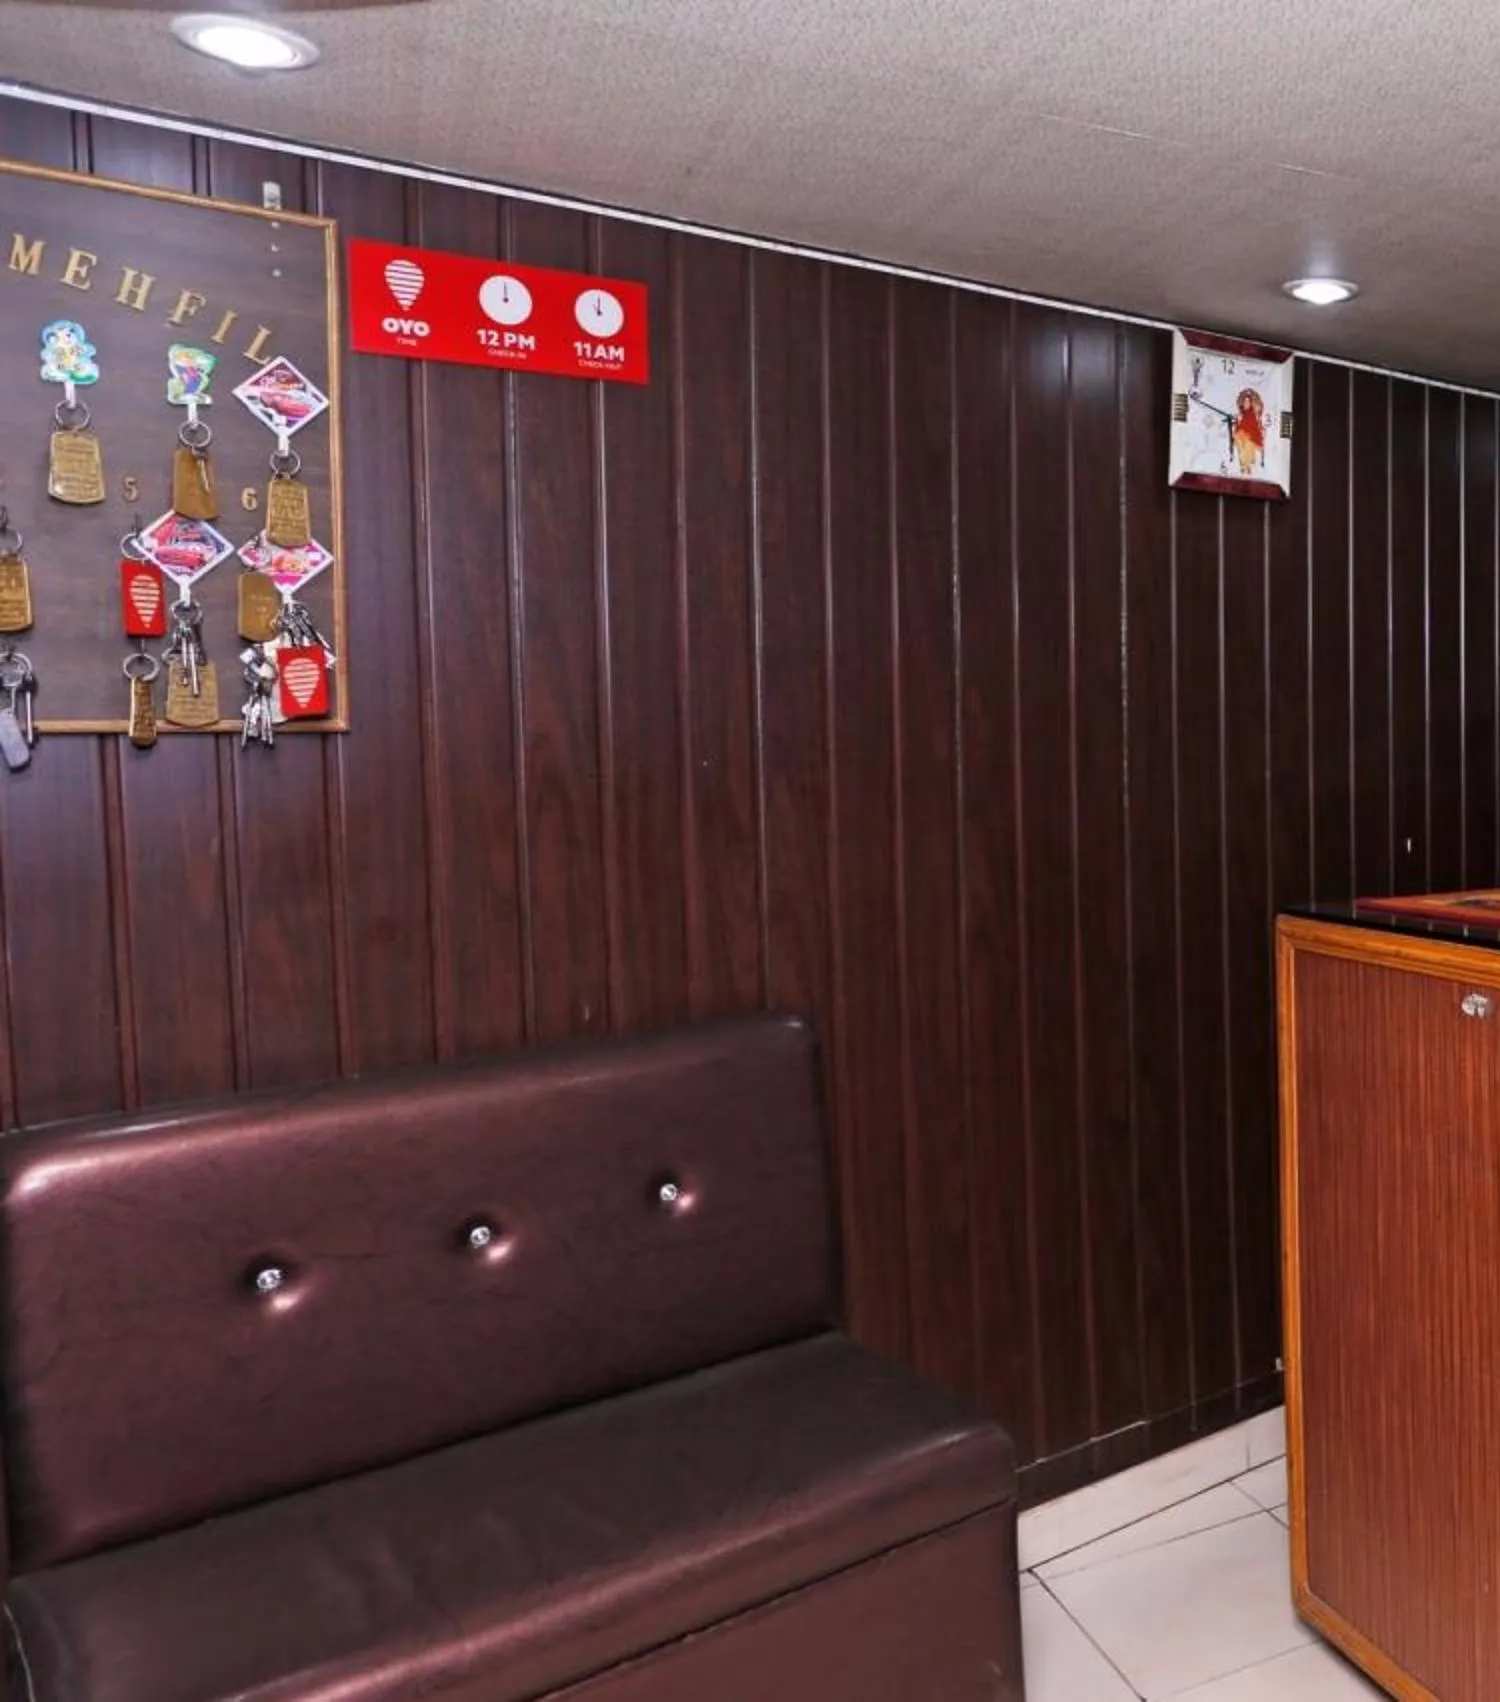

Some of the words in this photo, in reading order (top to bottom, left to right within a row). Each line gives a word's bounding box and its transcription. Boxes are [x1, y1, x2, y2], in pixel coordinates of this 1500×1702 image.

[8, 232, 272, 365] MEHFIL
[382, 317, 430, 338] OYO
[476, 329, 499, 348] 12
[503, 332, 536, 350] PM
[123, 476, 139, 501] 5
[240, 487, 259, 511] 6
